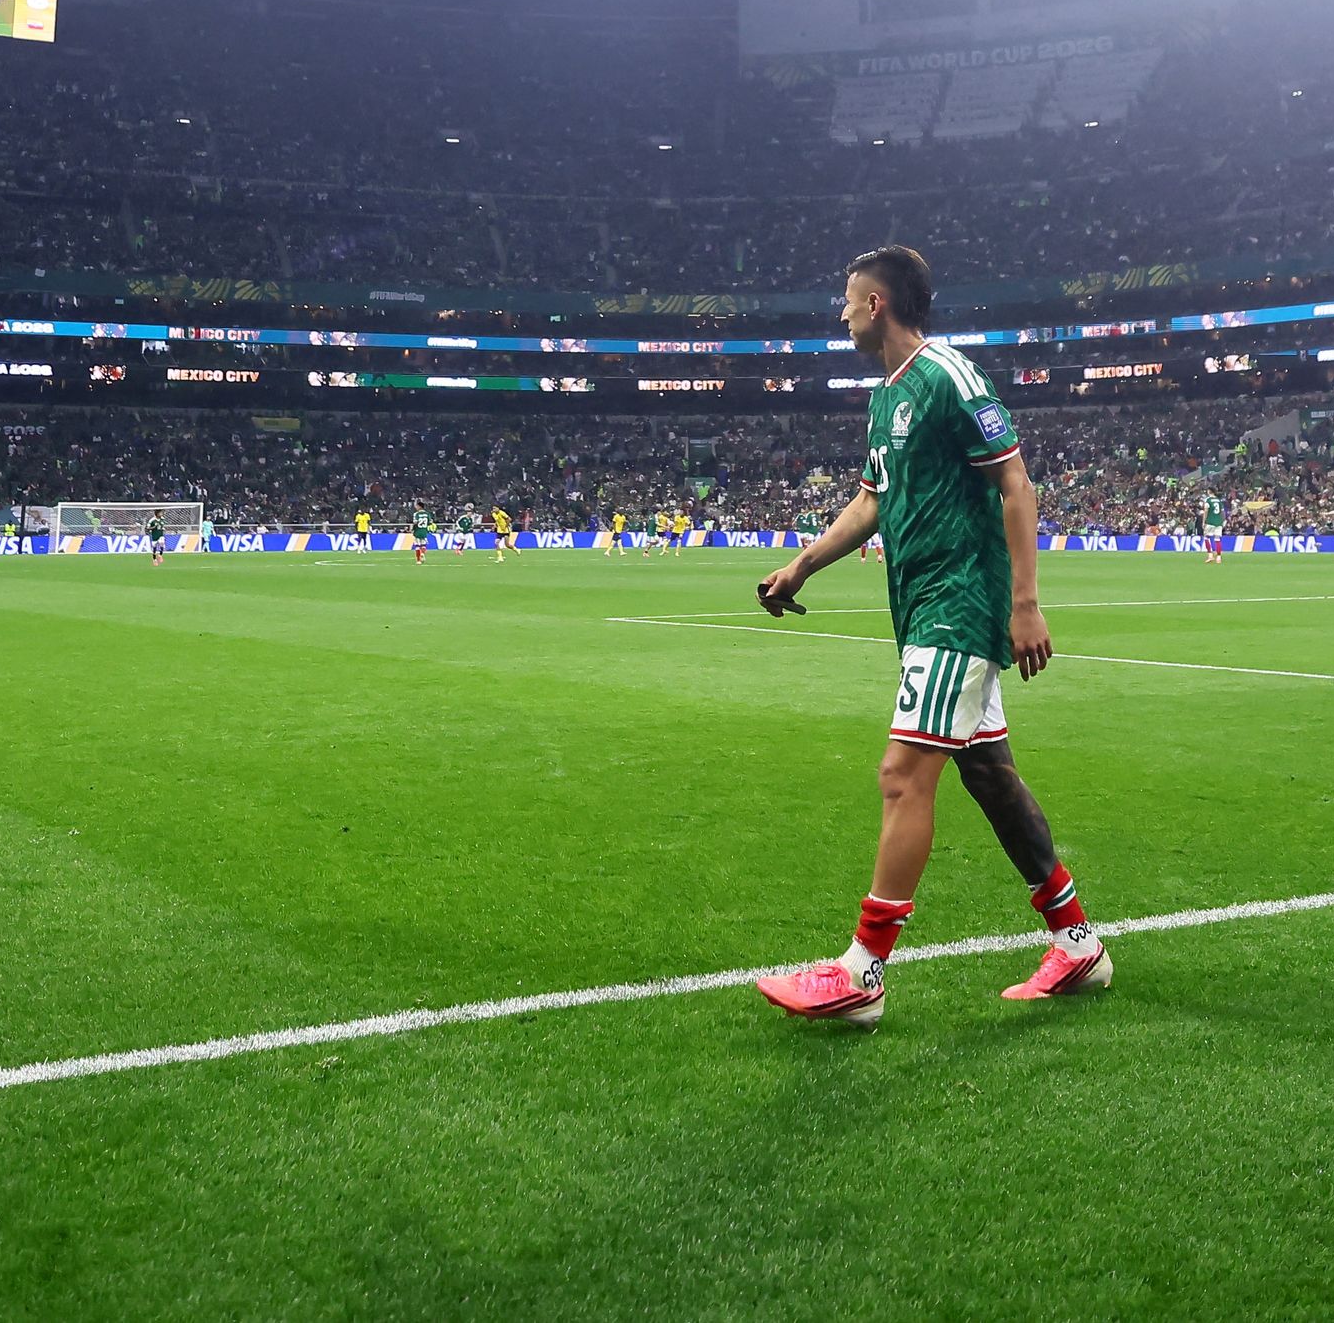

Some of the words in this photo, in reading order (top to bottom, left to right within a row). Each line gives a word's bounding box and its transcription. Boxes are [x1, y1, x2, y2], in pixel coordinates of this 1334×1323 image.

[859, 54, 906, 75] FIFA
[907, 48, 985, 72] WORLD
[991, 44, 1034, 66] CUP
[1038, 36, 1113, 59] 2026
[169, 327, 224, 340] MICO
[227, 329, 260, 341] CITY
[638, 342, 690, 352] MEXICO
[692, 342, 724, 352] CITY
[167, 368, 223, 382] MEXICO
[226, 370, 259, 383] CITY
[1084, 365, 1132, 379] MEXICO
[1133, 363, 1163, 376] CITY
[638, 380, 691, 391] MEXICO
[693, 380, 725, 391] CITY
[1214, 503, 1220, 514] 3
[417, 518, 427, 528] 23
[103, 536, 151, 552] VISA
[218, 535, 264, 551] VISA
[329, 534, 369, 551] VIS
[432, 533, 476, 549] VIA
[532, 532, 574, 548] VISA
[724, 531, 760, 547] VISA
[1079, 536, 1118, 552] VISA
[1270, 536, 1318, 552] VISA
[899, 666, 925, 712] 5
